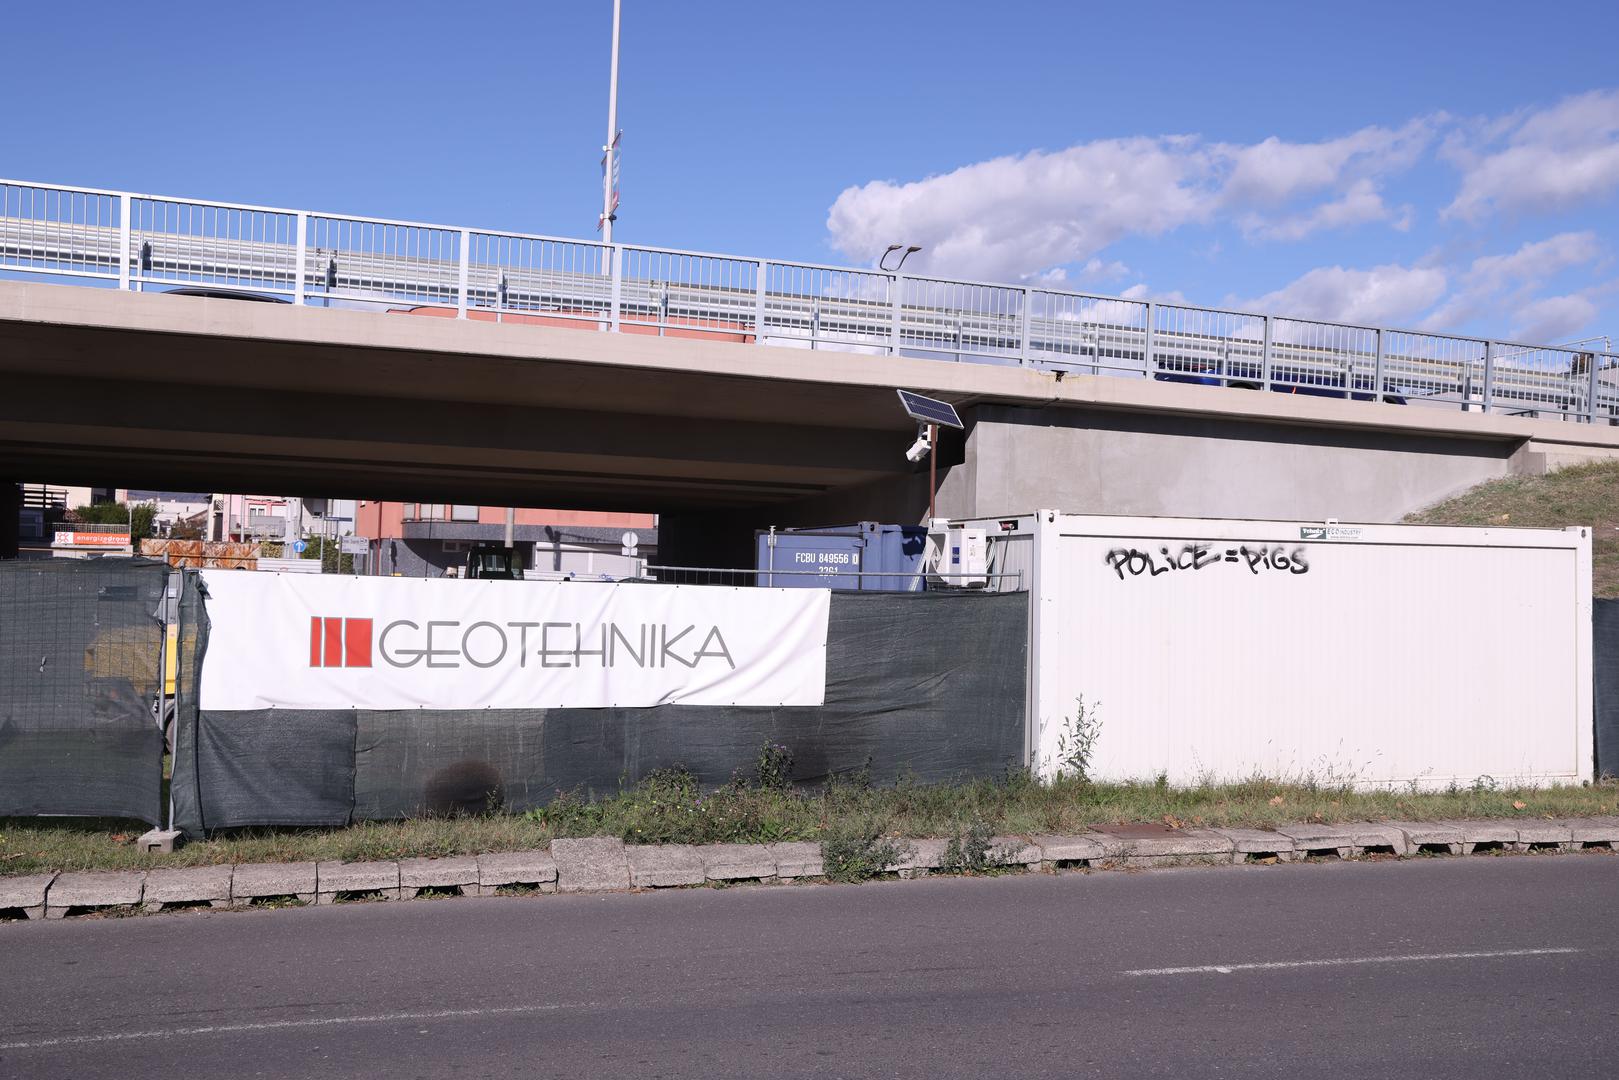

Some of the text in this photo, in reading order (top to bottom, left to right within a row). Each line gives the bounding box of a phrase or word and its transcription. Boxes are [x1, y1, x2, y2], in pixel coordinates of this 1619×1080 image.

[795, 552, 859, 565] FCBU 849556 0
[378, 619, 736, 669] GEOTEHNIKA
